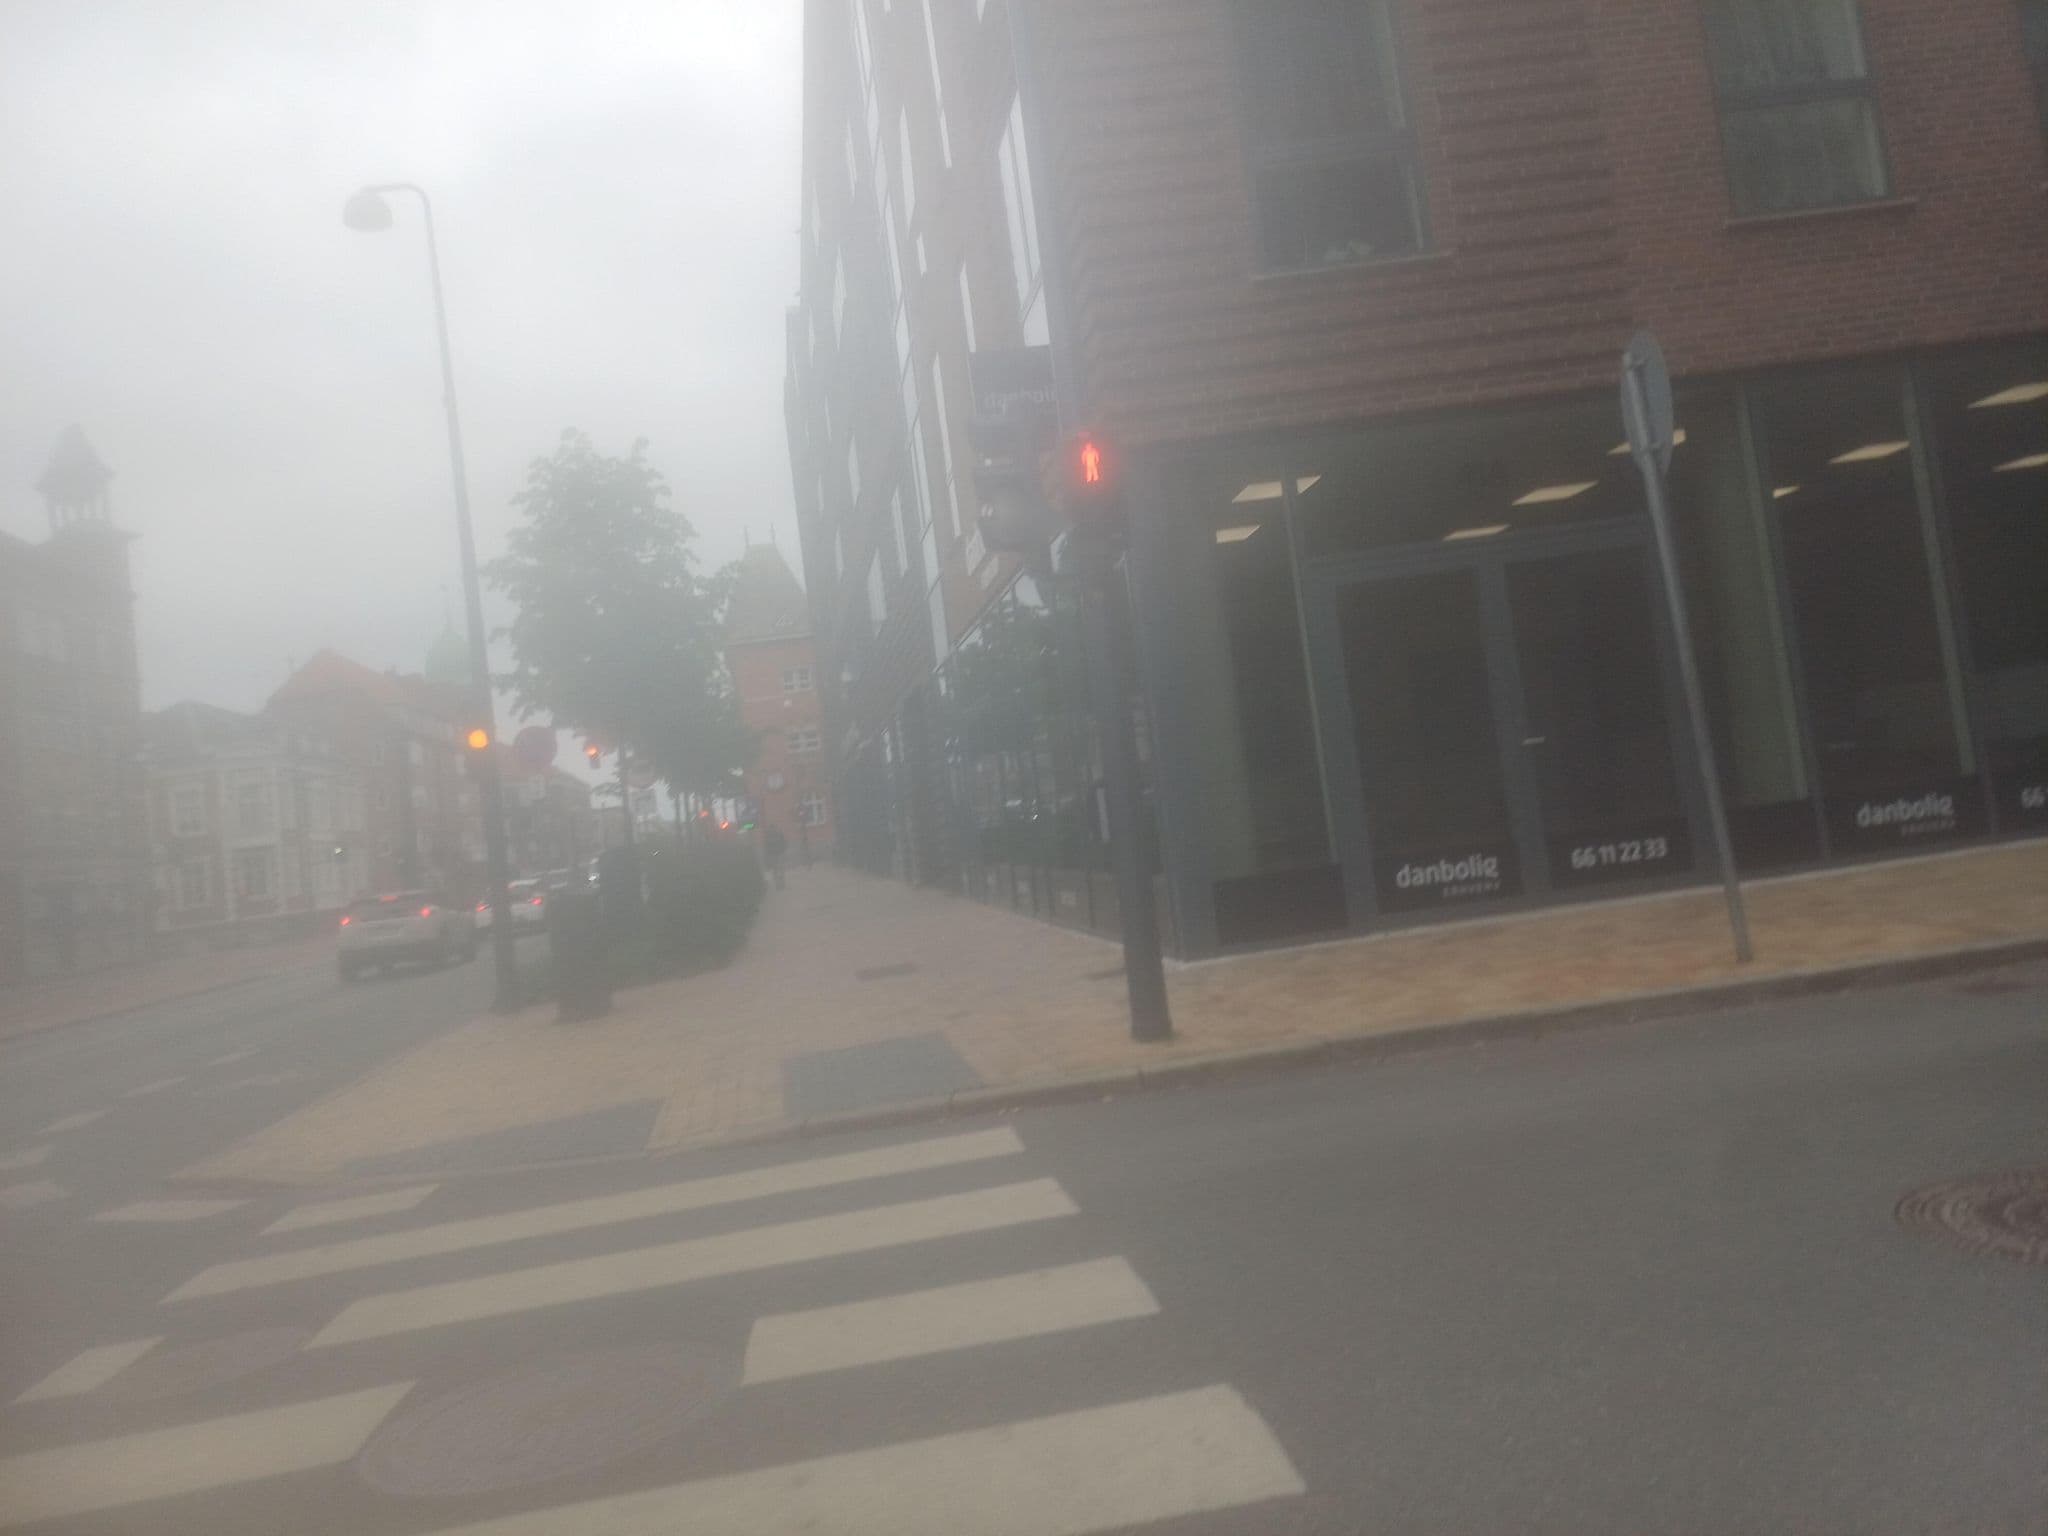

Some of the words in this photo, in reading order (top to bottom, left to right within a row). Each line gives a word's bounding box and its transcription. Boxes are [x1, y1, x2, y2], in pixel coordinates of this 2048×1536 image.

[1855, 793, 1955, 828] danbolig
[1396, 853, 1499, 888] danbolig
[1571, 846, 1596, 869] 66
[1598, 844, 1616, 865] 11
[1617, 840, 1641, 863] 22
[1642, 837, 1667, 860] 33
